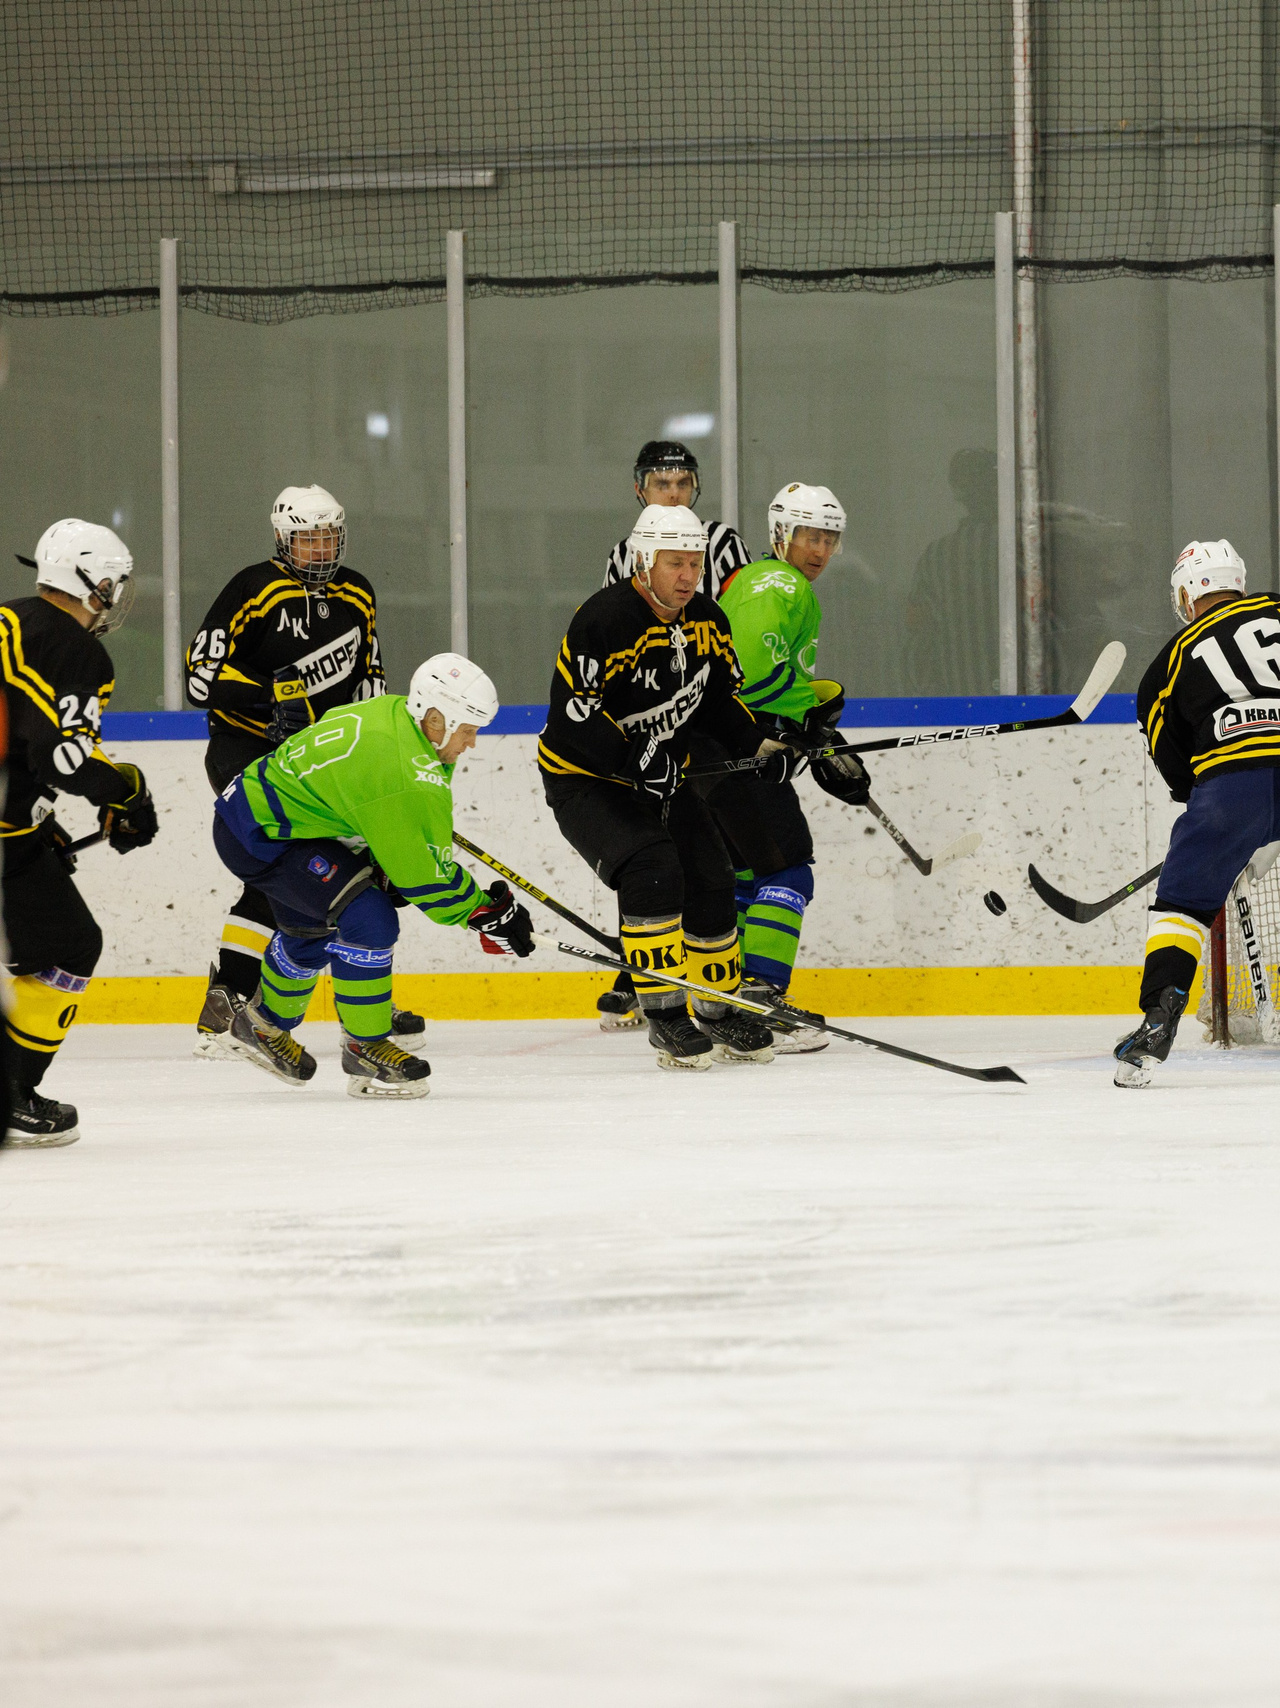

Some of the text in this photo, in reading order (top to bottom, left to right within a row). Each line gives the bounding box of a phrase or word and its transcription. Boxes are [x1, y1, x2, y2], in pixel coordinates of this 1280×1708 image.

[191, 628, 226, 663] 26
[58, 694, 102, 732] 24
[896, 723, 1000, 748] FISCHER
[483, 854, 545, 901] TRUE
[559, 942, 597, 958] CCM
